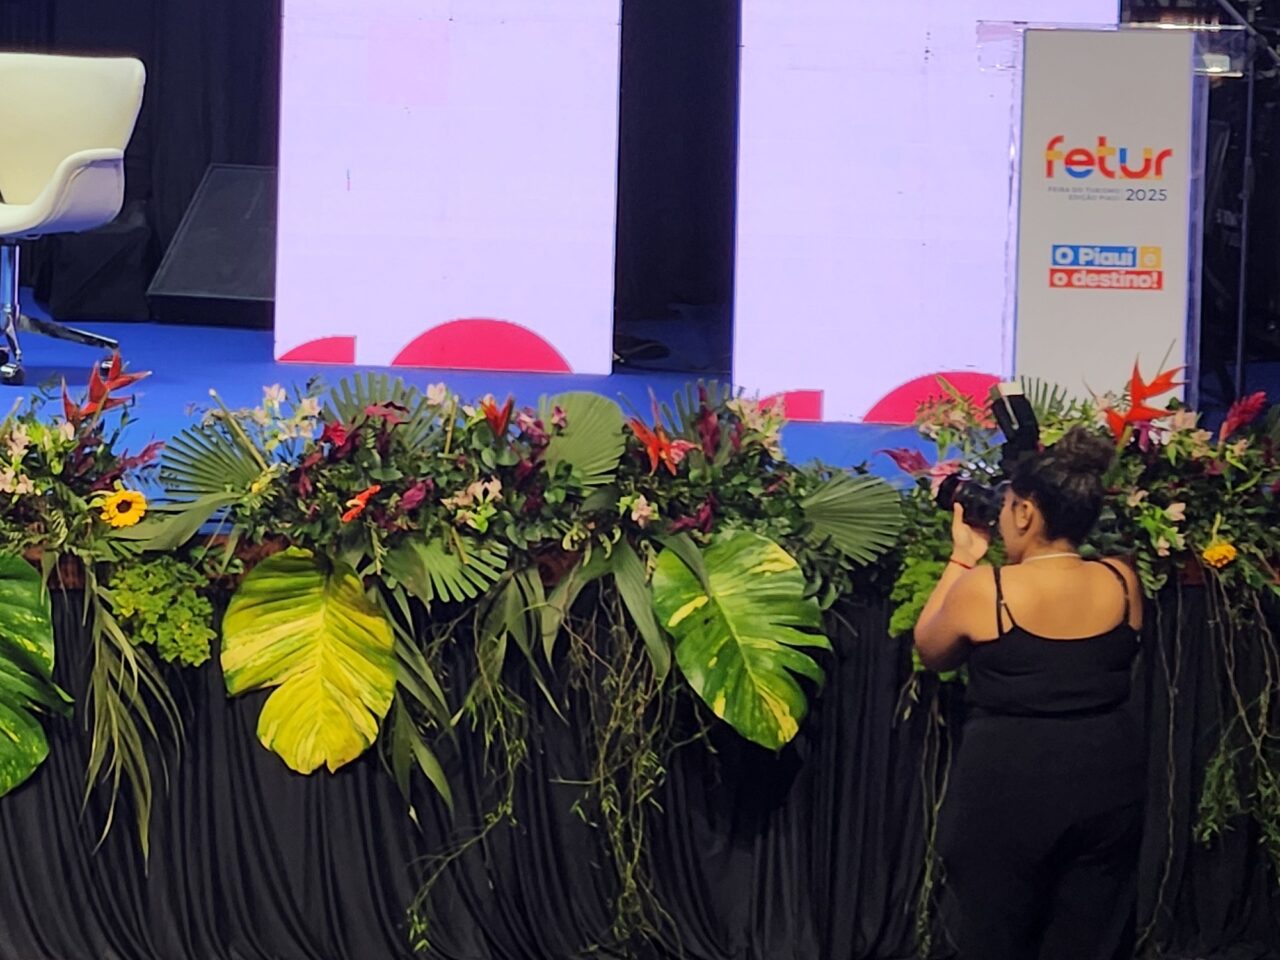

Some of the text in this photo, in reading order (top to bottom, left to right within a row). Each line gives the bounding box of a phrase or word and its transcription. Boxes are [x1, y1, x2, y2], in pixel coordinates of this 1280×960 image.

[1045, 135, 1174, 180] fetur
[1126, 188, 1168, 202] 2025
[1055, 247, 1074, 264] O
[1078, 247, 1134, 266] Piauí
[1052, 270, 1159, 289] o destino!
